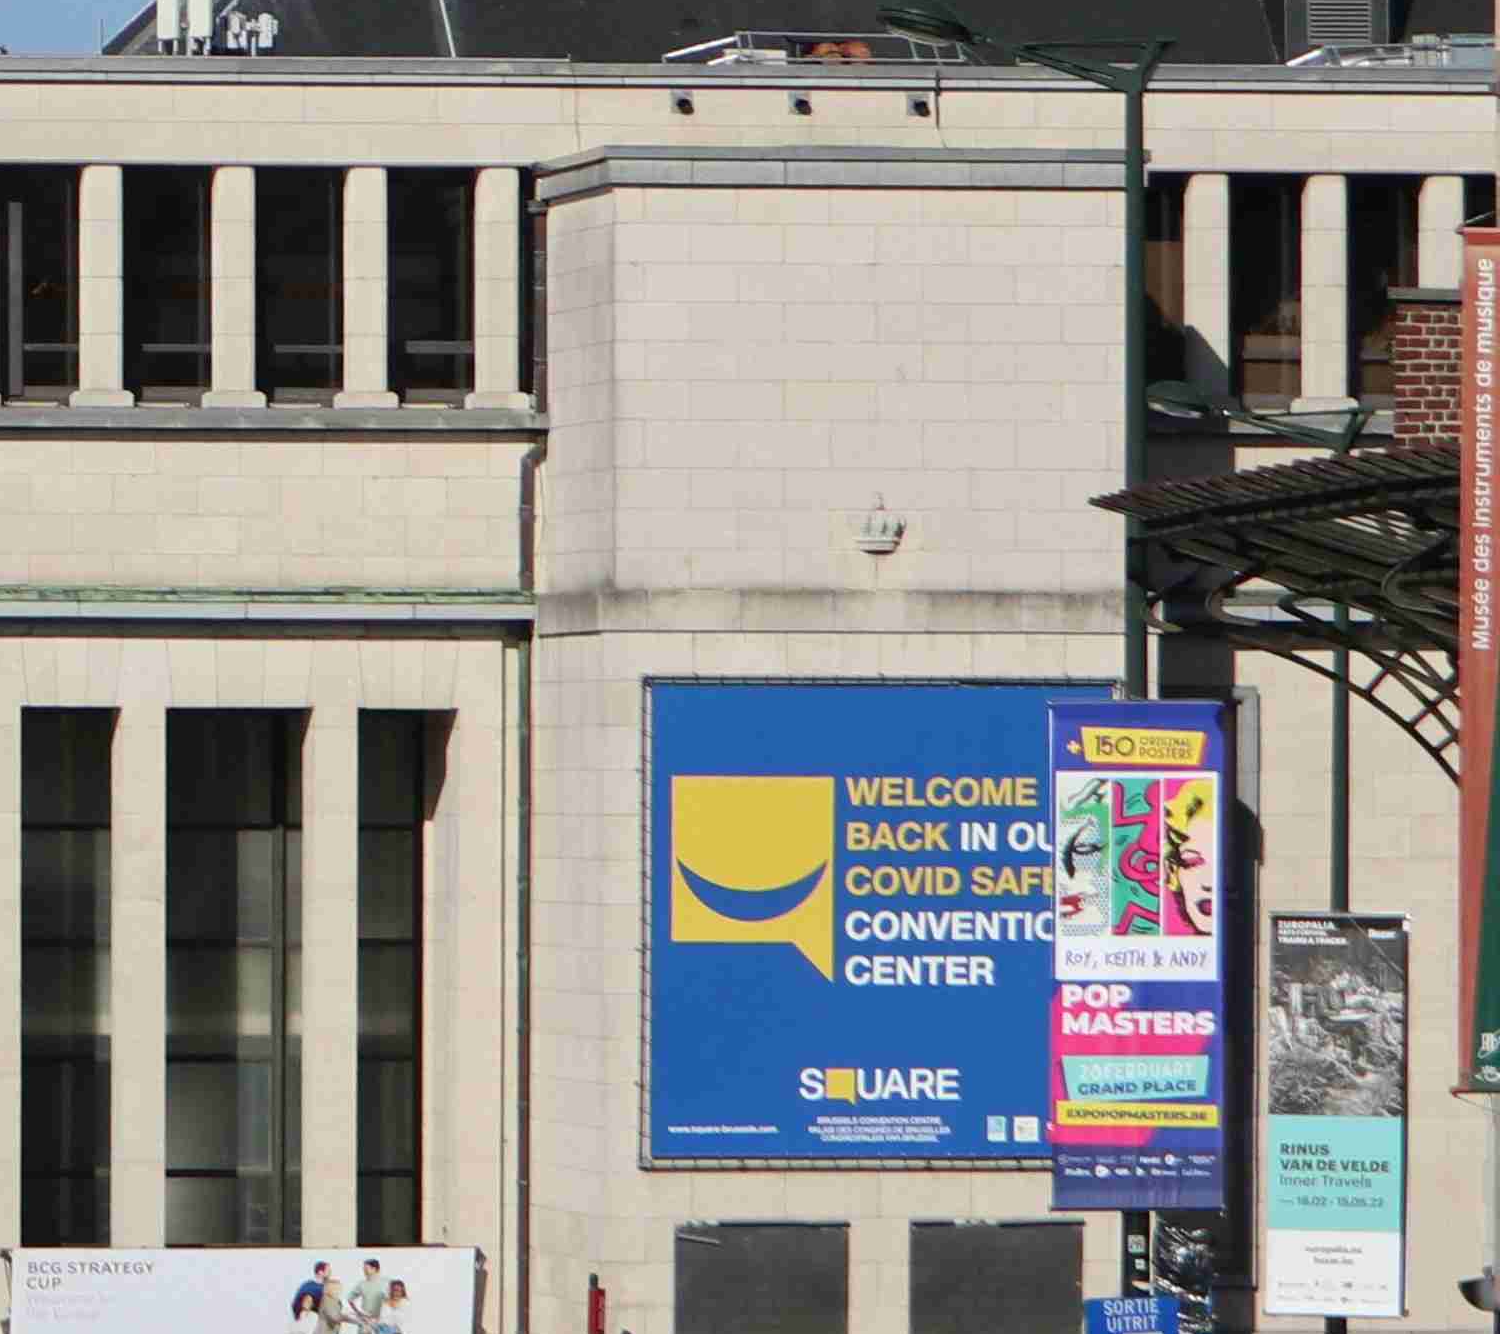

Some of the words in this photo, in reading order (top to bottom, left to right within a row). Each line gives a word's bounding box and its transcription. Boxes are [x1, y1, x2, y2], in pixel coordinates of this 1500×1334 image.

[1474, 258, 1496, 352] musique
[1474, 360, 1493, 387] de
[1471, 534, 1491, 572] des
[1471, 578, 1491, 650] Musée
[1095, 735, 1135, 756] 150
[1139, 748, 1193, 760] POSTERS
[844, 776, 1038, 807] WELCOME
[846, 821, 950, 852] BACK
[960, 821, 998, 852] IN
[1007, 821, 1053, 852] OU
[844, 866, 962, 896] COVID
[1104, 949, 1146, 967] KEITH
[1152, 950, 1163, 967] &
[1170, 949, 1207, 967] ANDY
[844, 955, 996, 986] CENTER
[1061, 983, 1132, 1009] POP
[1061, 1011, 1216, 1036] MASTERS
[1077, 1082, 1139, 1096] GRAND
[1143, 1080, 1197, 1094] PLACE
[1280, 1143, 1330, 1156] RINUS
[1280, 1159, 1313, 1172] VAN
[1316, 1160, 1338, 1172] DE
[1340, 1160, 1389, 1173] VELDE
[1279, 1174, 1318, 1187] Inner
[1323, 1175, 1372, 1188] Travels
[27, 1261, 62, 1275] BCG
[67, 1261, 156, 1275] STRATEGY
[26, 1276, 62, 1290] CUP
[1103, 1299, 1160, 1316] SORTIE
[1106, 1315, 1158, 1333] UITRIT
